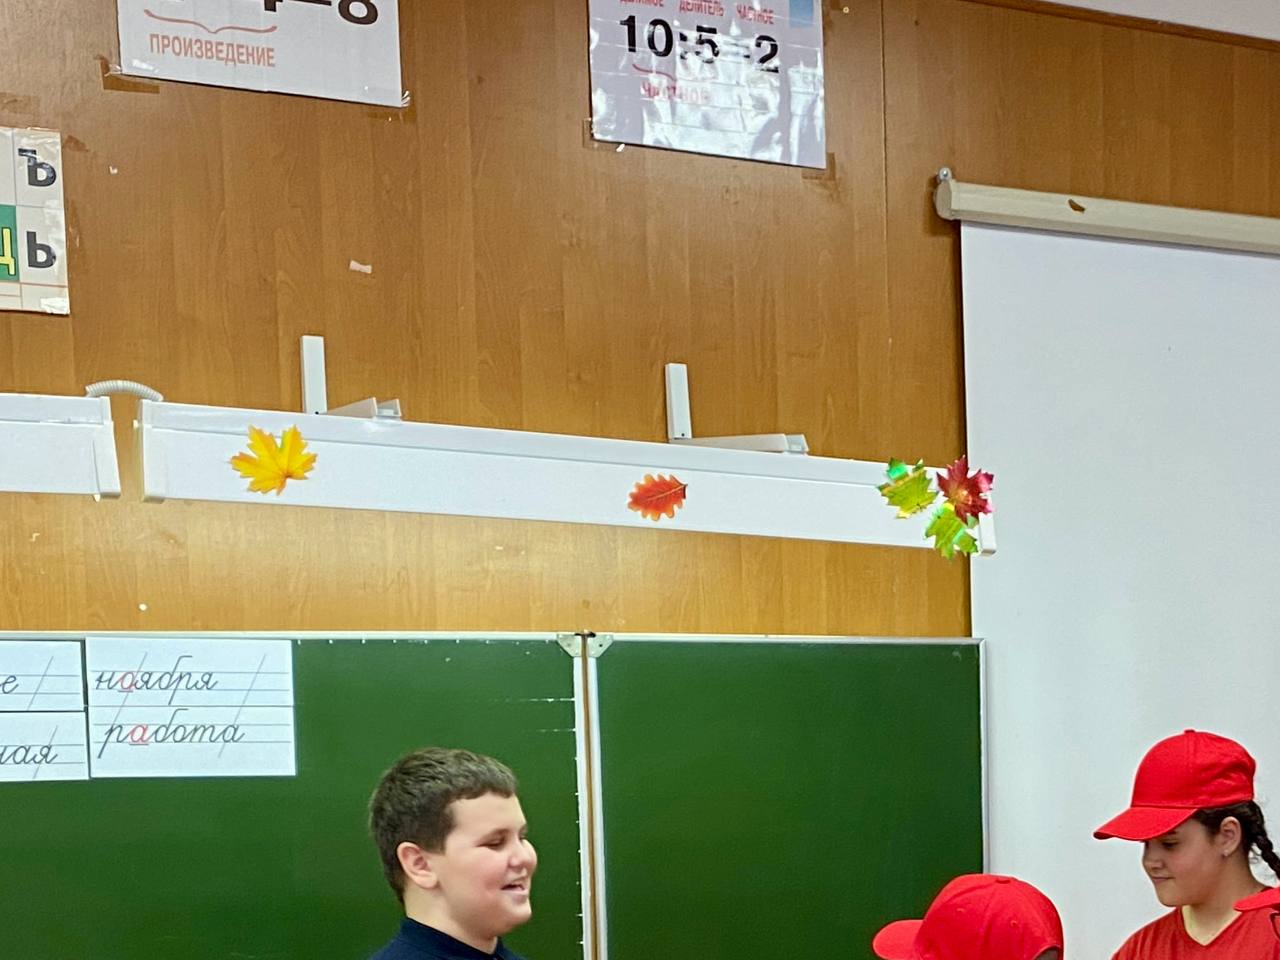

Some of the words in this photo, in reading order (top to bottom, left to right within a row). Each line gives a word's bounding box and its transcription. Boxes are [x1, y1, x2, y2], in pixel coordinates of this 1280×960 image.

[150, 33, 276, 67] ПРОИЗВЕДЕНИЕ
[18, 148, 57, 187] Ъ
[26, 231, 57, 268] Ь
[95, 656, 219, 706] ноября
[97, 708, 246, 759] работа
